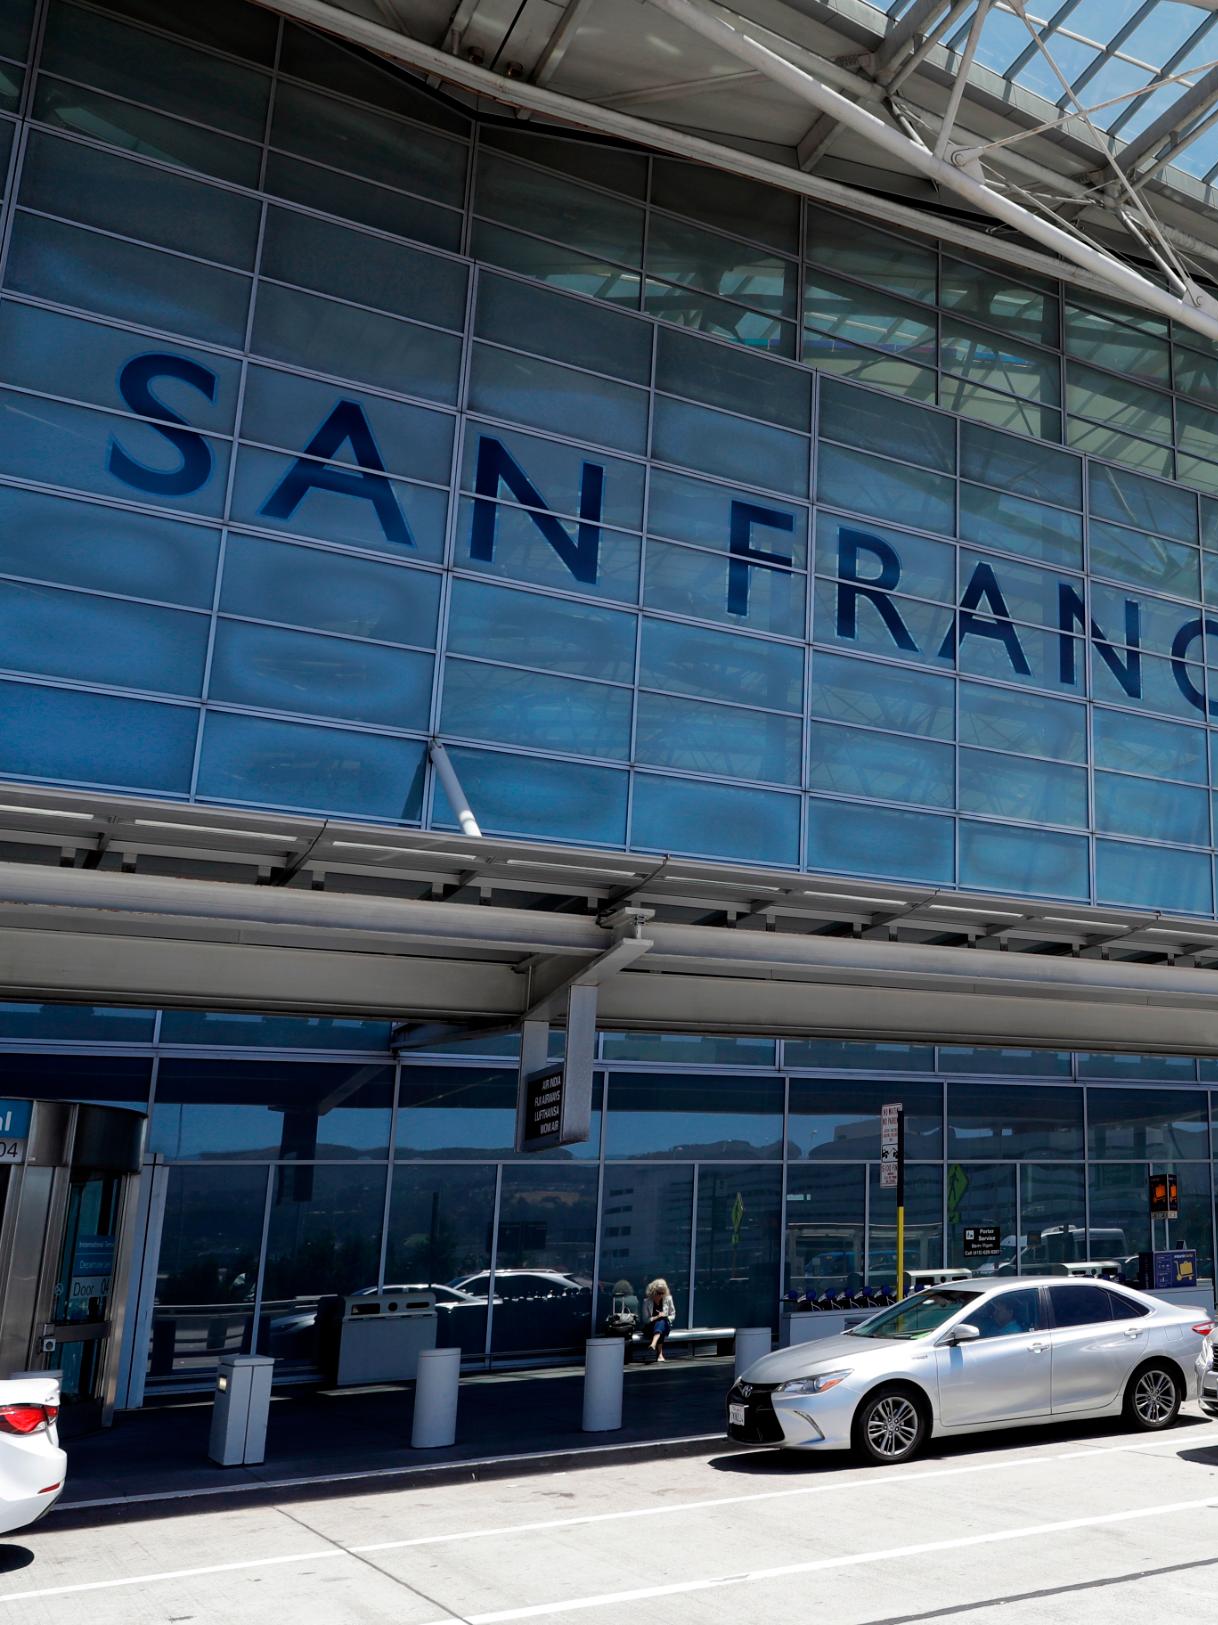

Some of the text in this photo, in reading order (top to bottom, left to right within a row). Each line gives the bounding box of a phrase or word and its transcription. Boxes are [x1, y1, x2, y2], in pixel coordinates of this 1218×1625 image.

[109, 353, 605, 585] SAN
[534, 1105, 559, 1122] LUFTHANSA
[73, 1281, 96, 1297] Door
